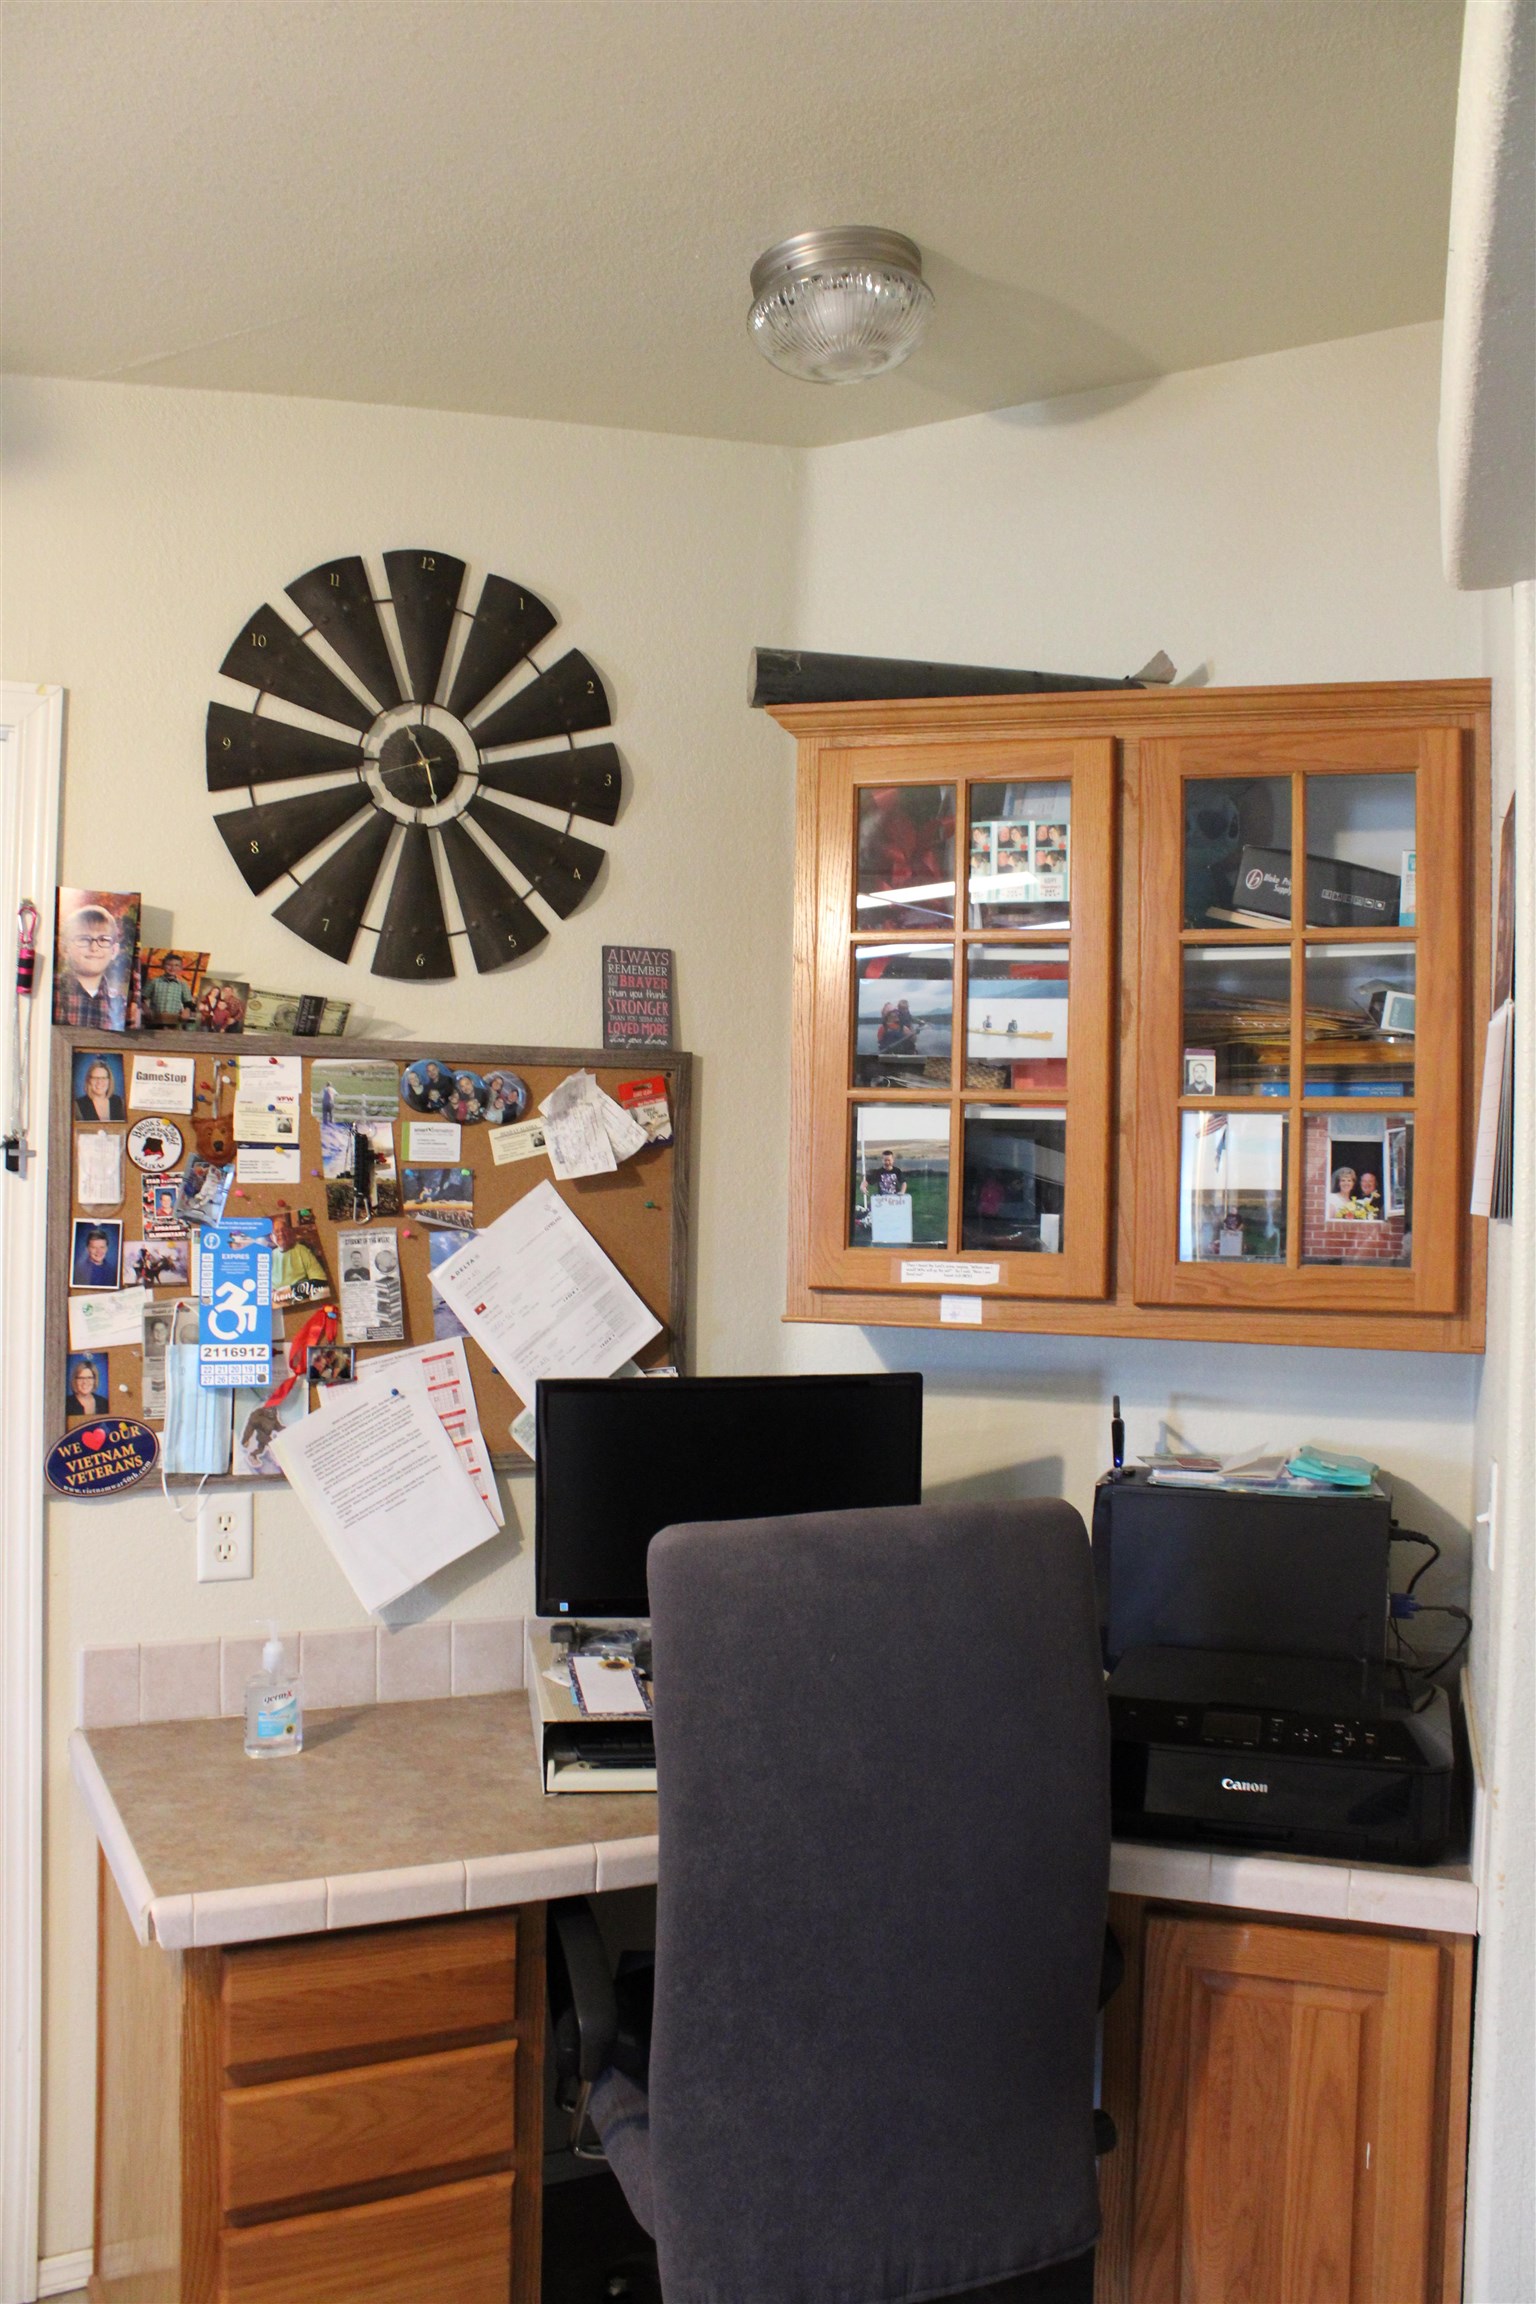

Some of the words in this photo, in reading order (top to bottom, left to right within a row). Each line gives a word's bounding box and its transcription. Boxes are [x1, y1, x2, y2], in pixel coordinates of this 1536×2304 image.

[421, 556, 435, 571] 12
[330, 573, 340, 587] 11
[519, 597, 525, 610] 1
[251, 633, 267, 647] 10
[587, 680, 595, 694] 2
[223, 737, 231, 750] 9
[604, 774, 612, 786] 3
[250, 840, 260, 854] 8
[573, 868, 581, 880] 4
[322, 918, 330, 932] 7
[508, 935, 517, 948] 5
[415, 953, 425, 967] 6
[607, 948, 669, 966] ALWAYS
[607, 963, 668, 977] REMEMBER
[620, 975, 668, 989] BRAVER
[608, 987, 627, 998] than
[629, 990, 643, 1000] you
[646, 989, 668, 999] think
[607, 997, 669, 1016] STRONGER
[607, 1021, 640, 1034] LOVED
[641, 1023, 668, 1036] MORE
[136, 1071, 187, 1083] GameStop
[454, 1258, 475, 1276] DELTA
[203, 1347, 267, 1358] 211691Z
[57, 1441, 83, 1458] WE
[108, 1425, 142, 1443] OUR
[65, 1443, 136, 1473] VIETNAM
[63, 1460, 152, 1495] www.vietnamwar50th.com
[65, 1454, 144, 1487] VETERANS
[1221, 1777, 1268, 1794] Canon
